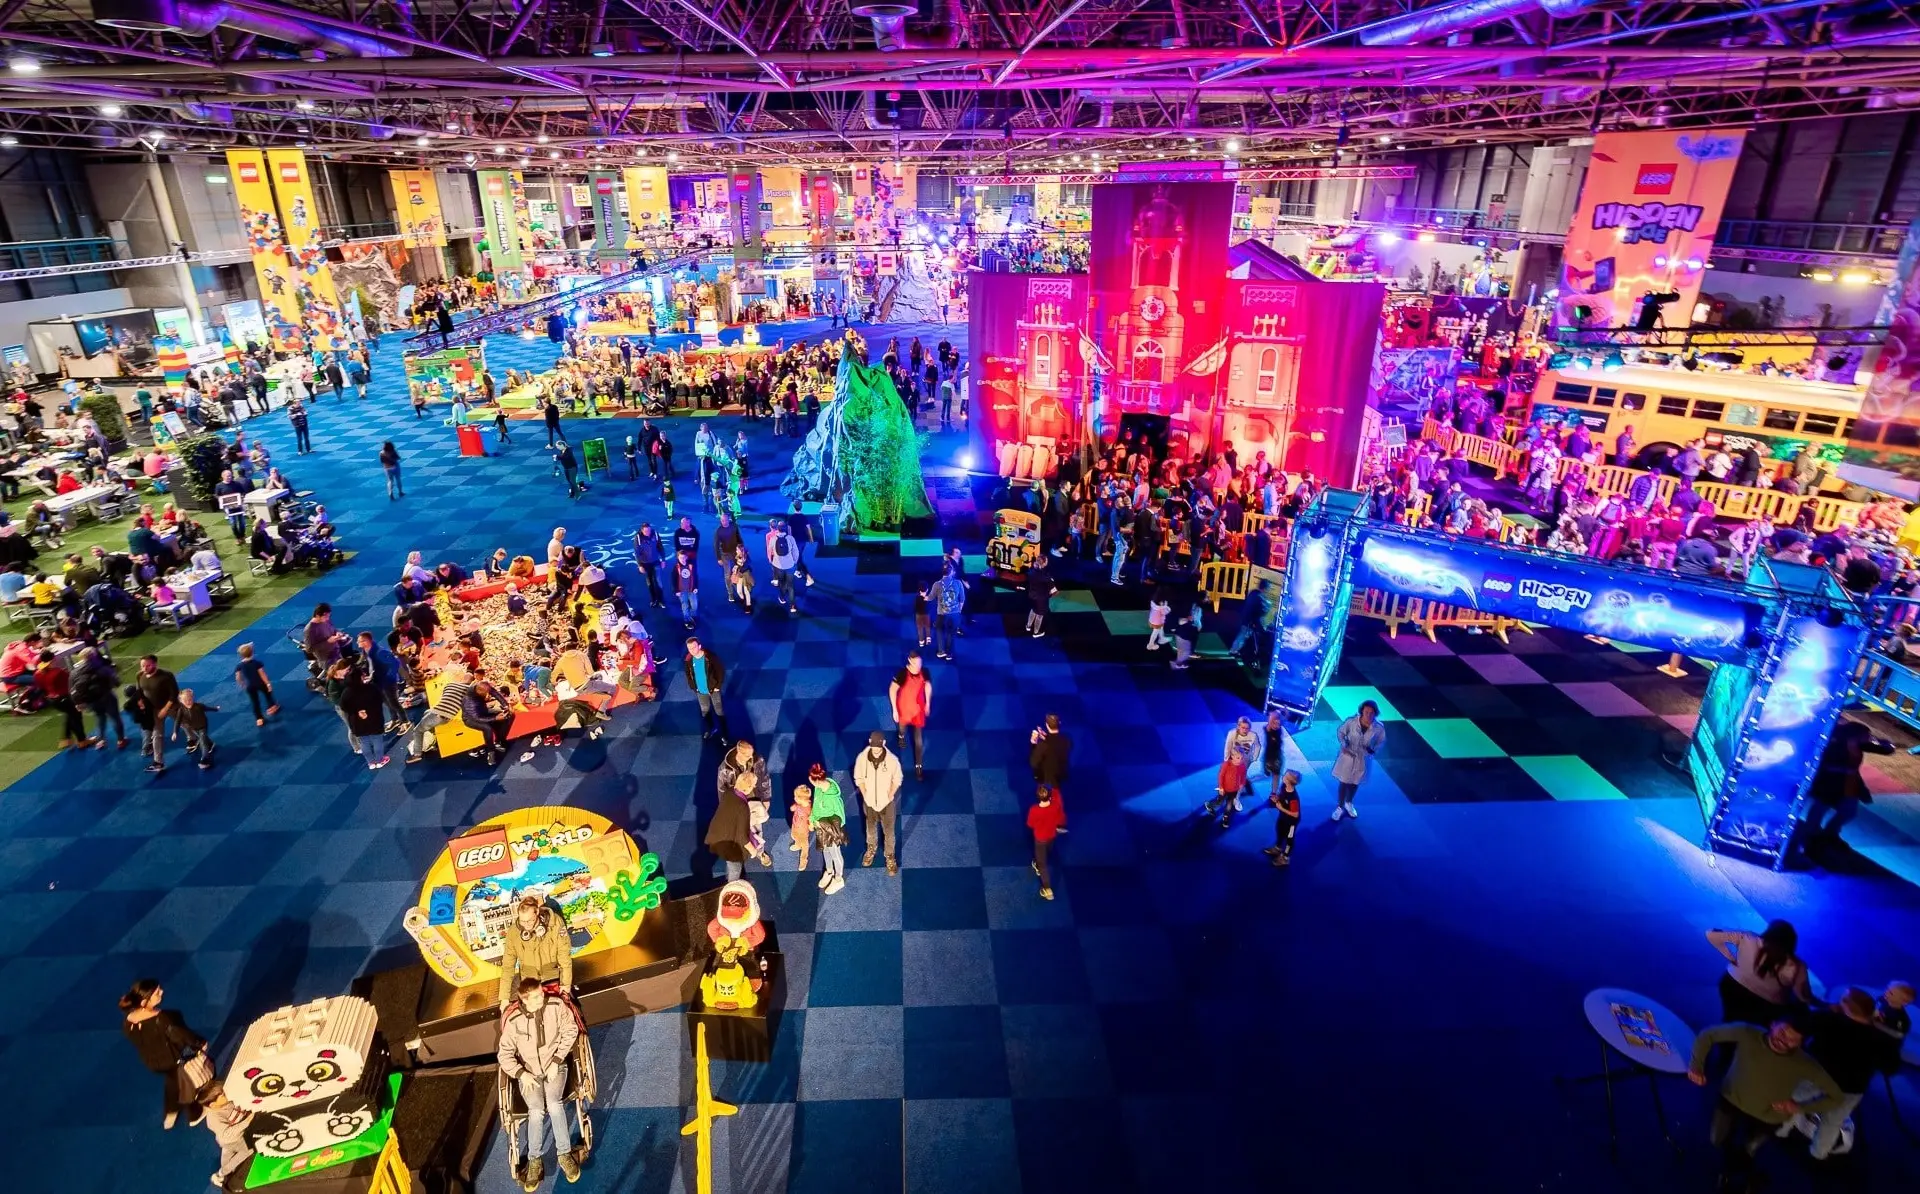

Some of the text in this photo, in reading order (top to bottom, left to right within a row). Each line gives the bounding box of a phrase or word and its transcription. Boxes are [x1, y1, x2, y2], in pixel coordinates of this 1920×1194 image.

[1639, 173, 1673, 186] LEGO
[1593, 202, 1703, 231] HIDDEN
[1520, 579, 1590, 608] HIDDEN
[457, 842, 506, 869] LEGO
